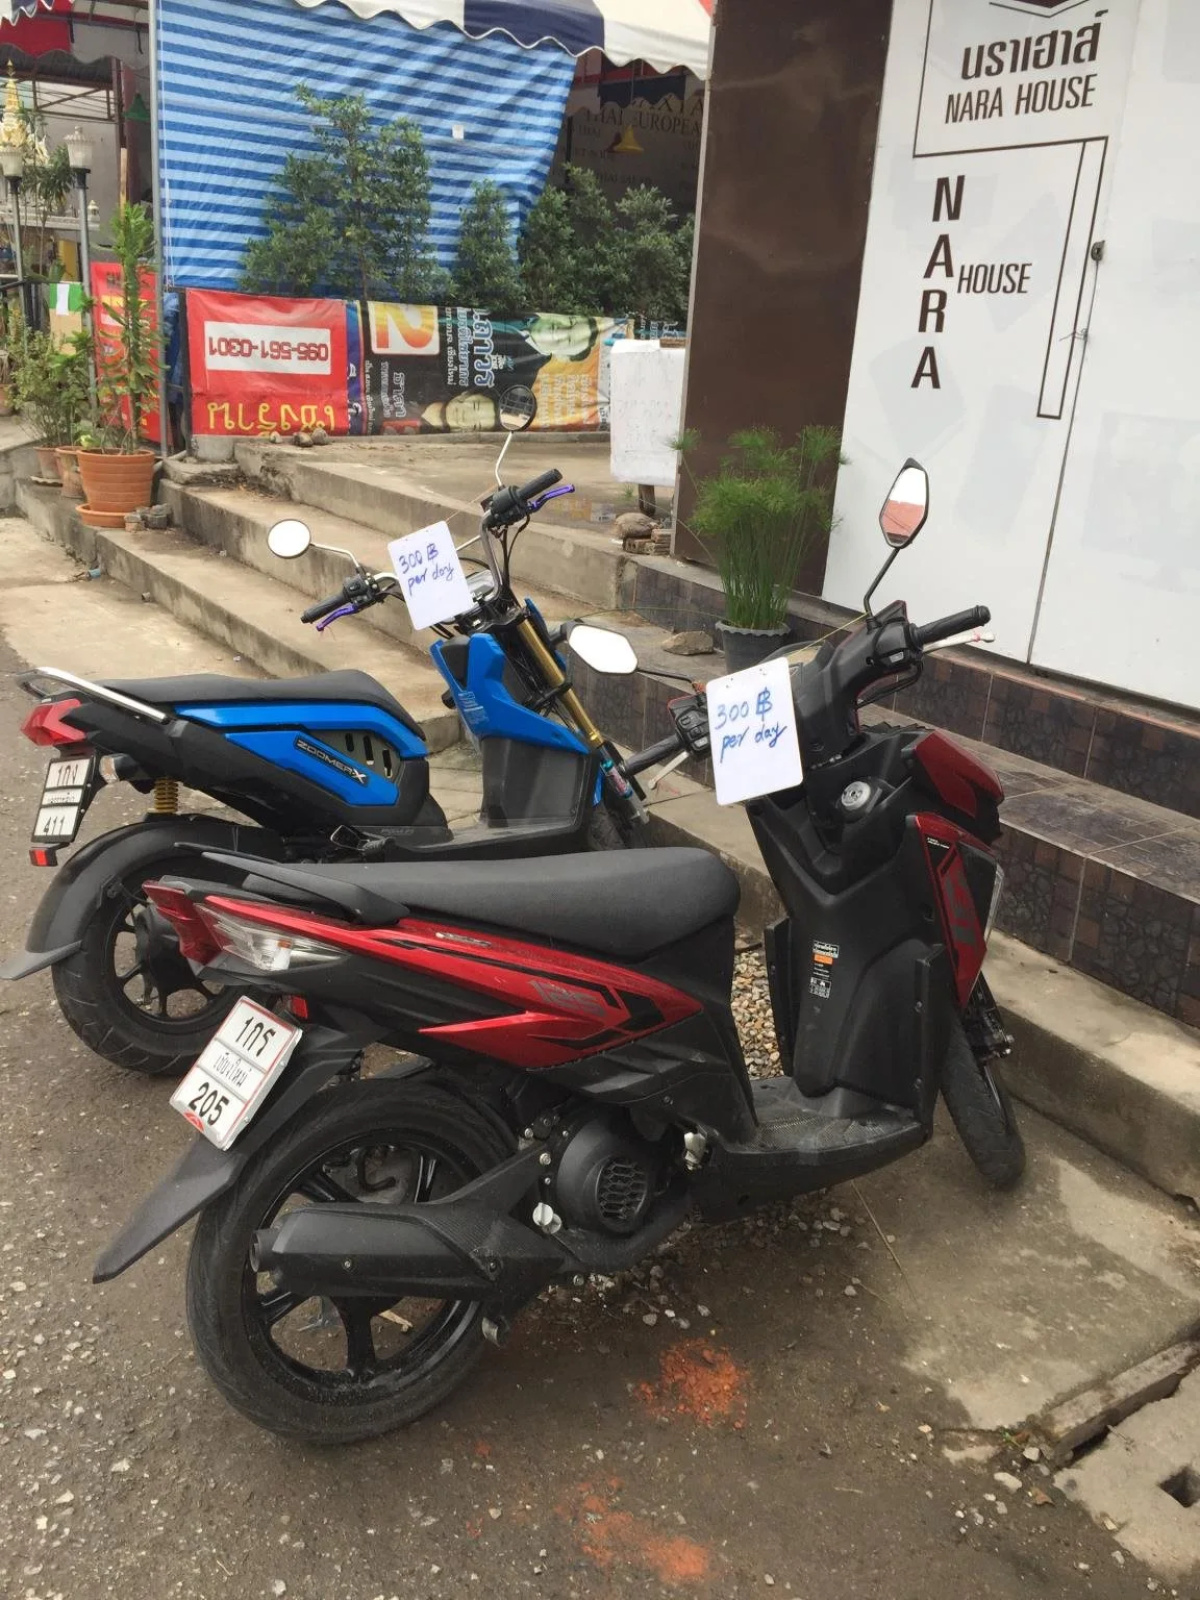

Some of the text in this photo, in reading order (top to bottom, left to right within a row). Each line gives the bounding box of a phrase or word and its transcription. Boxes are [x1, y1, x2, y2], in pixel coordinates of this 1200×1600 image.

[961, 9, 1108, 80] นราเฮาส์
[945, 74, 1098, 124] NARA HOUSE
[957, 263, 1033, 295] HOUSE
[375, 303, 435, 349] 2
[207, 337, 329, 361] 095-561-0301
[398, 550, 423, 574] 300
[407, 563, 455, 596] per day
[715, 701, 749, 729] 300
[720, 721, 788, 763] per day
[235, 1016, 276, 1057] 1กร
[188, 1081, 231, 1126] 205
